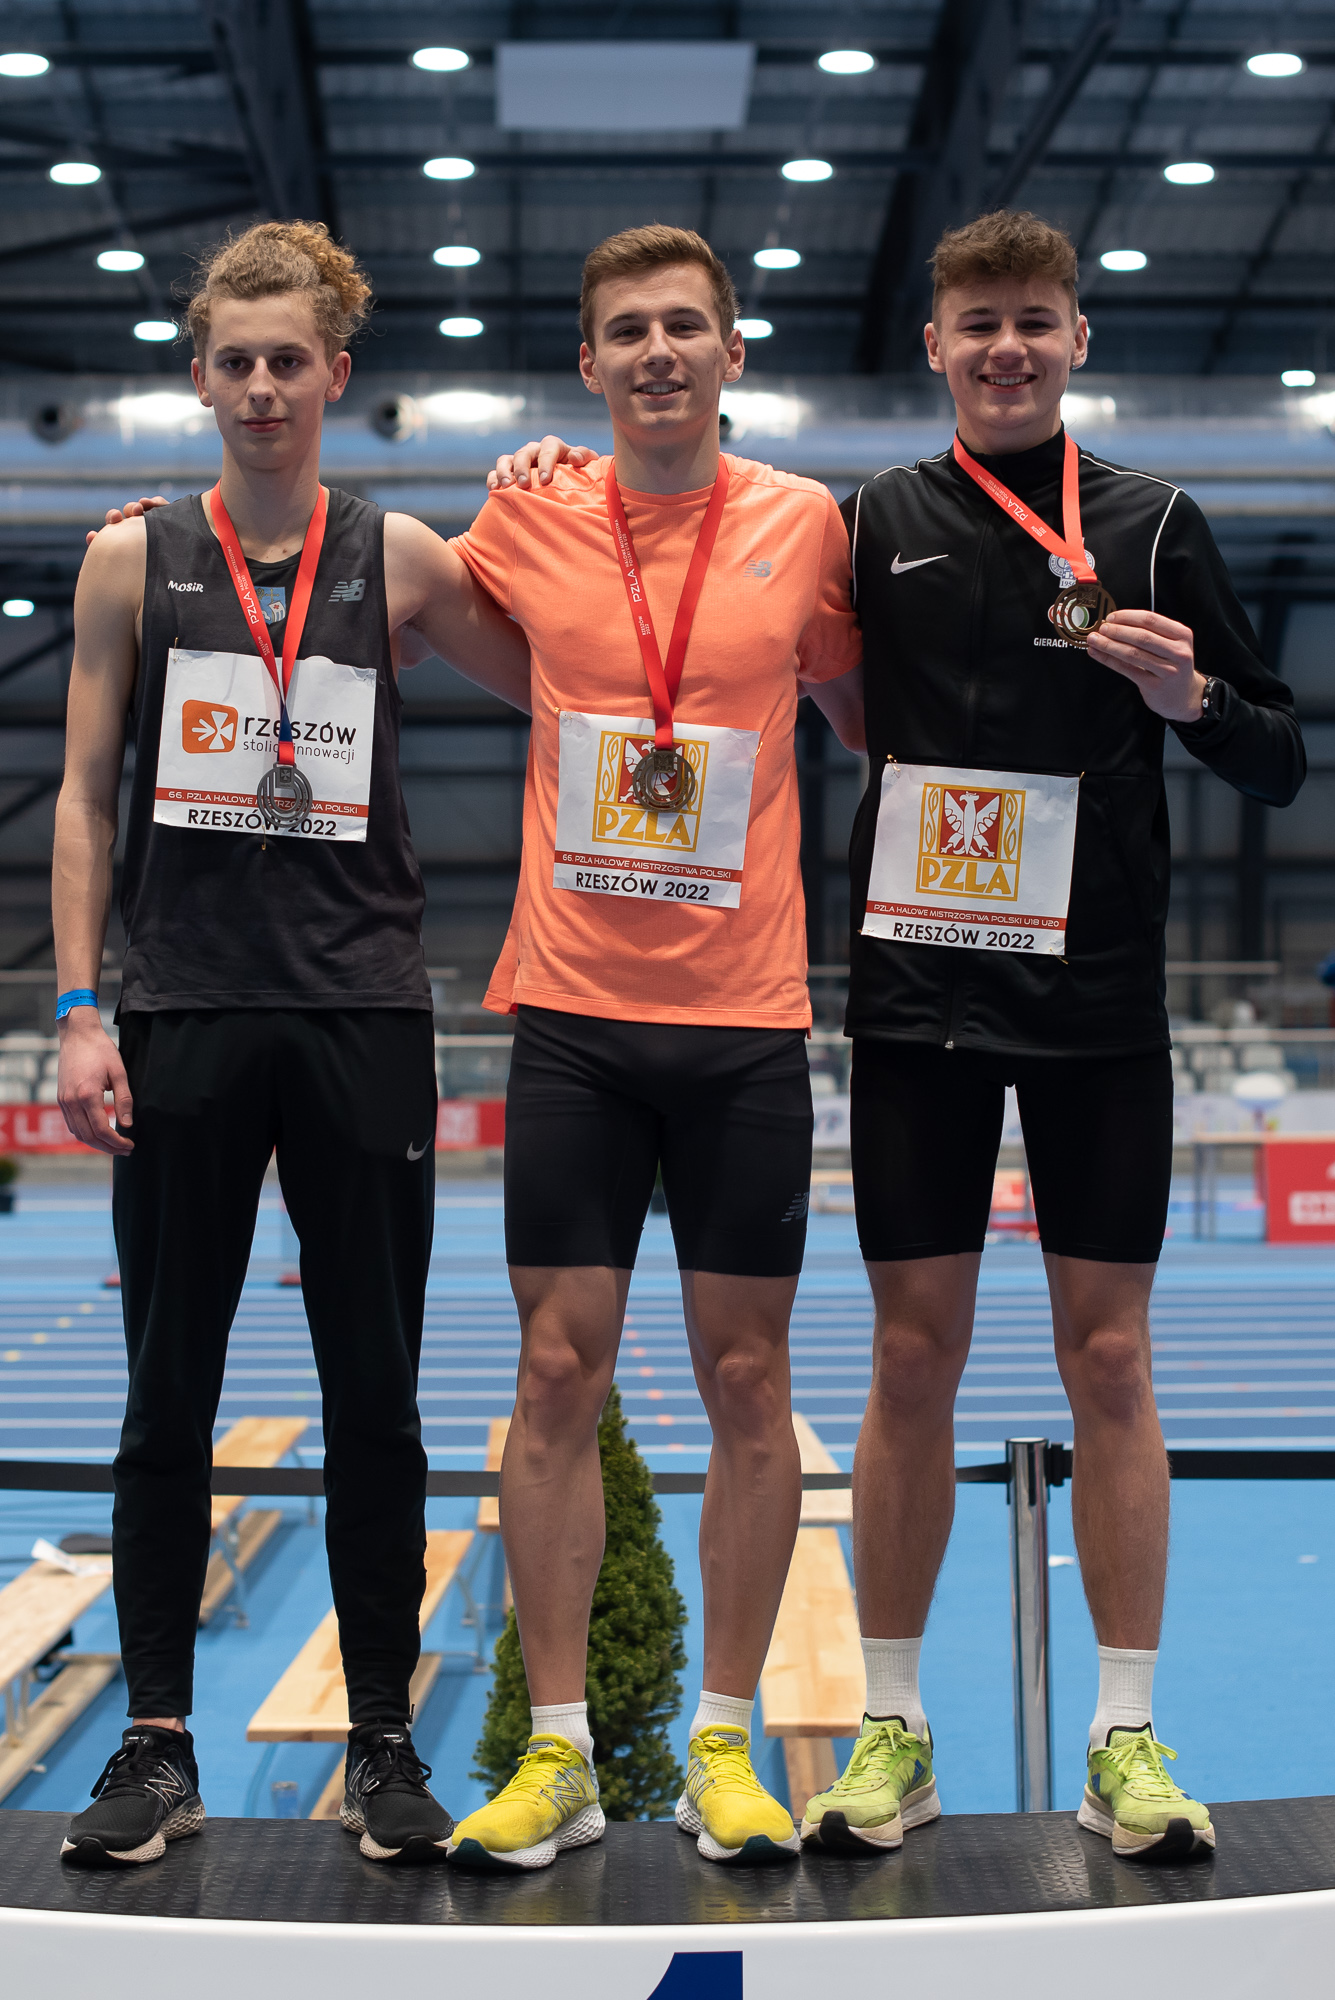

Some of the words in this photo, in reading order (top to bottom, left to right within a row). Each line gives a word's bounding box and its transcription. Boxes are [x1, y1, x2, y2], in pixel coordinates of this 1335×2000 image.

[1008, 498, 1029, 521] PZLA
[627, 568, 642, 603] PZLA
[243, 591, 260, 624] PZLA
[1033, 637, 1068, 648] GIERACH
[294, 742, 355, 764] innowacji
[168, 790, 185, 800] 66.
[186, 792, 212, 802] PZLA
[213, 795, 253, 805] HALOWE
[325, 803, 358, 814] POLSKI
[597, 806, 691, 846] PZLA
[562, 853, 574, 862] 66.
[575, 855, 593, 864] PZLA
[594, 857, 630, 868] HALOWE
[631, 861, 698, 876] MISTRZOSTWA
[700, 868, 731, 879] POLSKI
[921, 857, 1012, 895] PZLA
[576, 872, 658, 895] RZESZÓW
[663, 881, 710, 901] 2022
[873, 904, 895, 913] PZLA
[896, 906, 928, 917] HALOWE
[929, 909, 990, 922] MISTRZOSTWA
[991, 915, 1023, 925] POLSKI
[1023, 918, 1040, 926] U18
[1041, 919, 1060, 927] U20
[893, 922, 980, 945] RZESZÓW
[985, 931, 1035, 949] 2022
